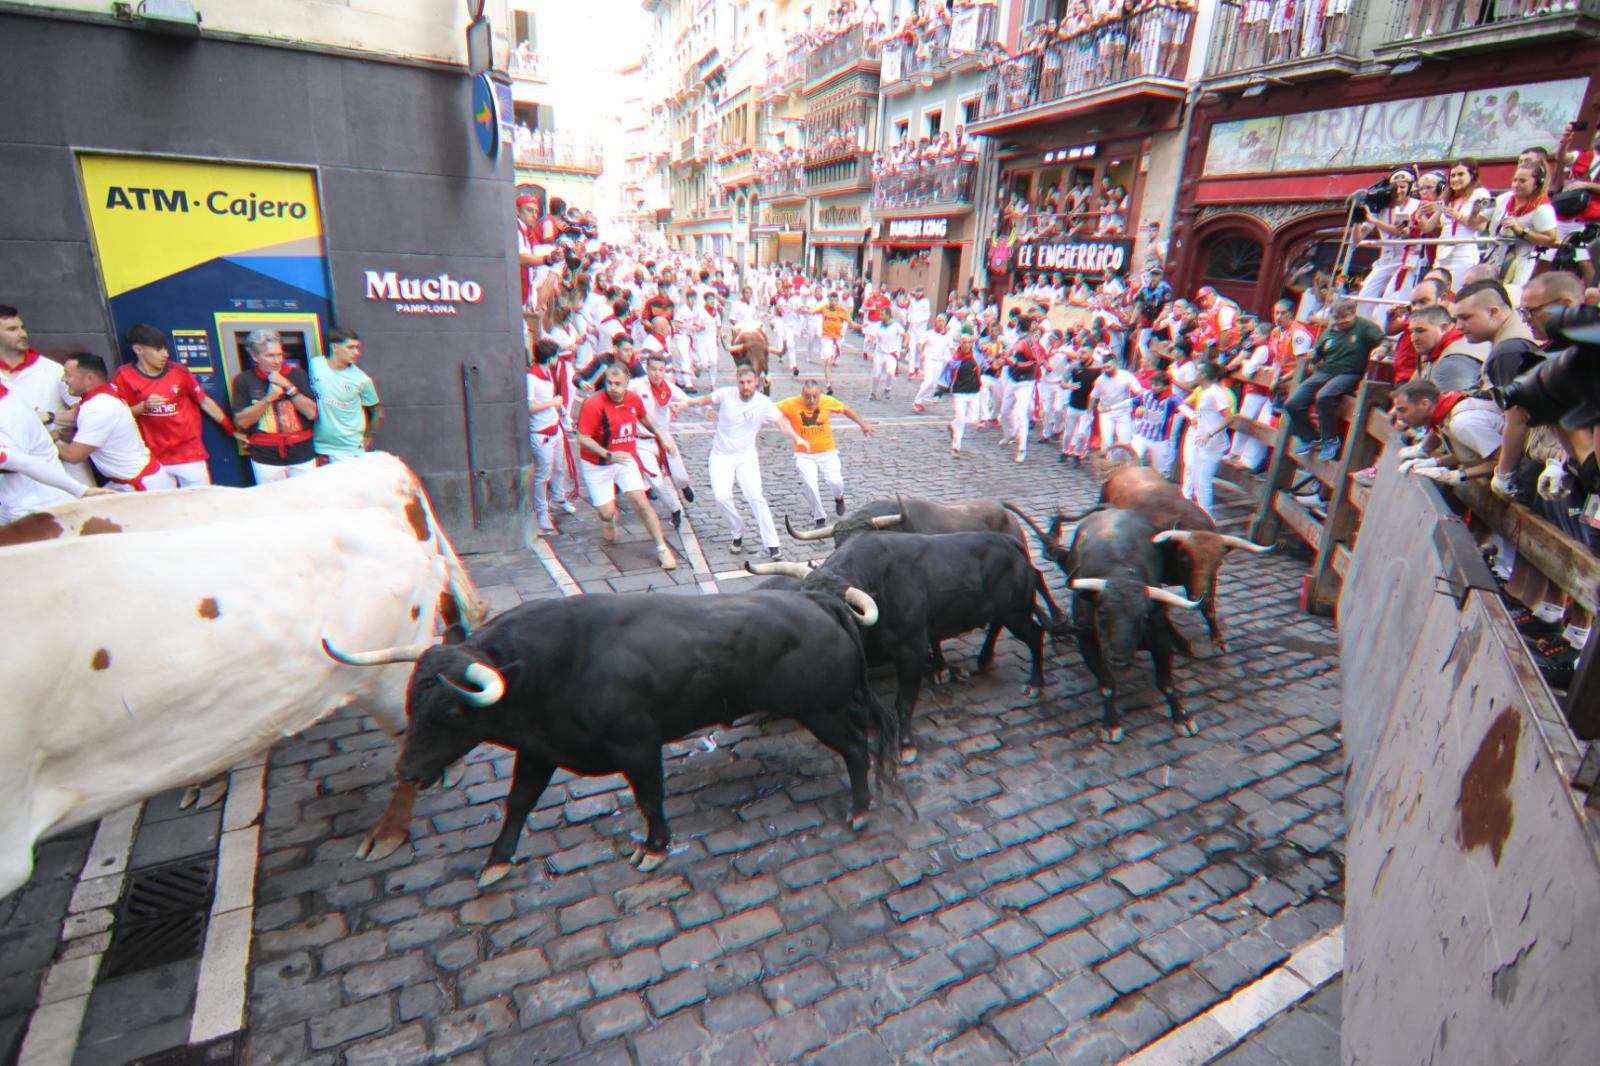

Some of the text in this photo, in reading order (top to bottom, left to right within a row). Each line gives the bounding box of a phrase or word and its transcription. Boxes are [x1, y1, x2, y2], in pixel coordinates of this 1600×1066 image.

[1282, 95, 1450, 152] FARMACIA
[106, 186, 307, 222] ATM Cajero
[923, 216, 948, 237] KING
[364, 270, 483, 304] Mucho
[395, 303, 457, 315] PAMPLONA
